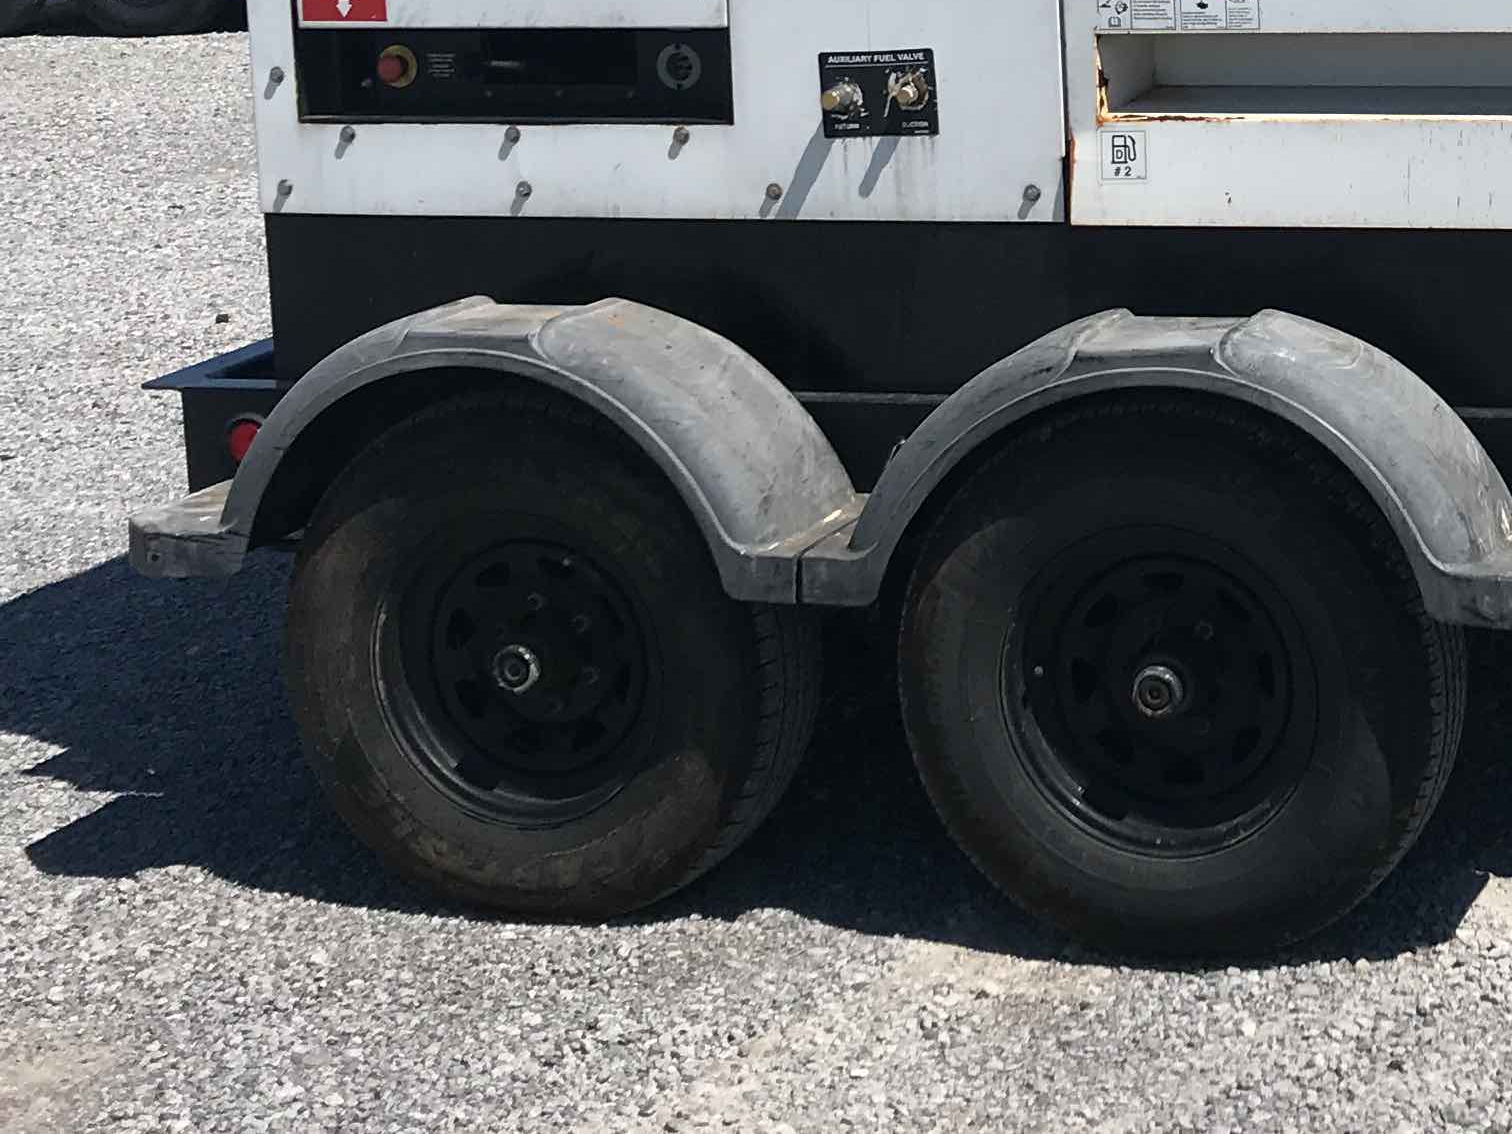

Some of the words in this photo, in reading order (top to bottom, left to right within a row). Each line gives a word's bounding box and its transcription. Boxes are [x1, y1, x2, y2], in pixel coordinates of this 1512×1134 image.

[827, 55, 872, 64] AUXILIARY
[873, 53, 896, 62] FUEL
[897, 52, 924, 61] VALVE
